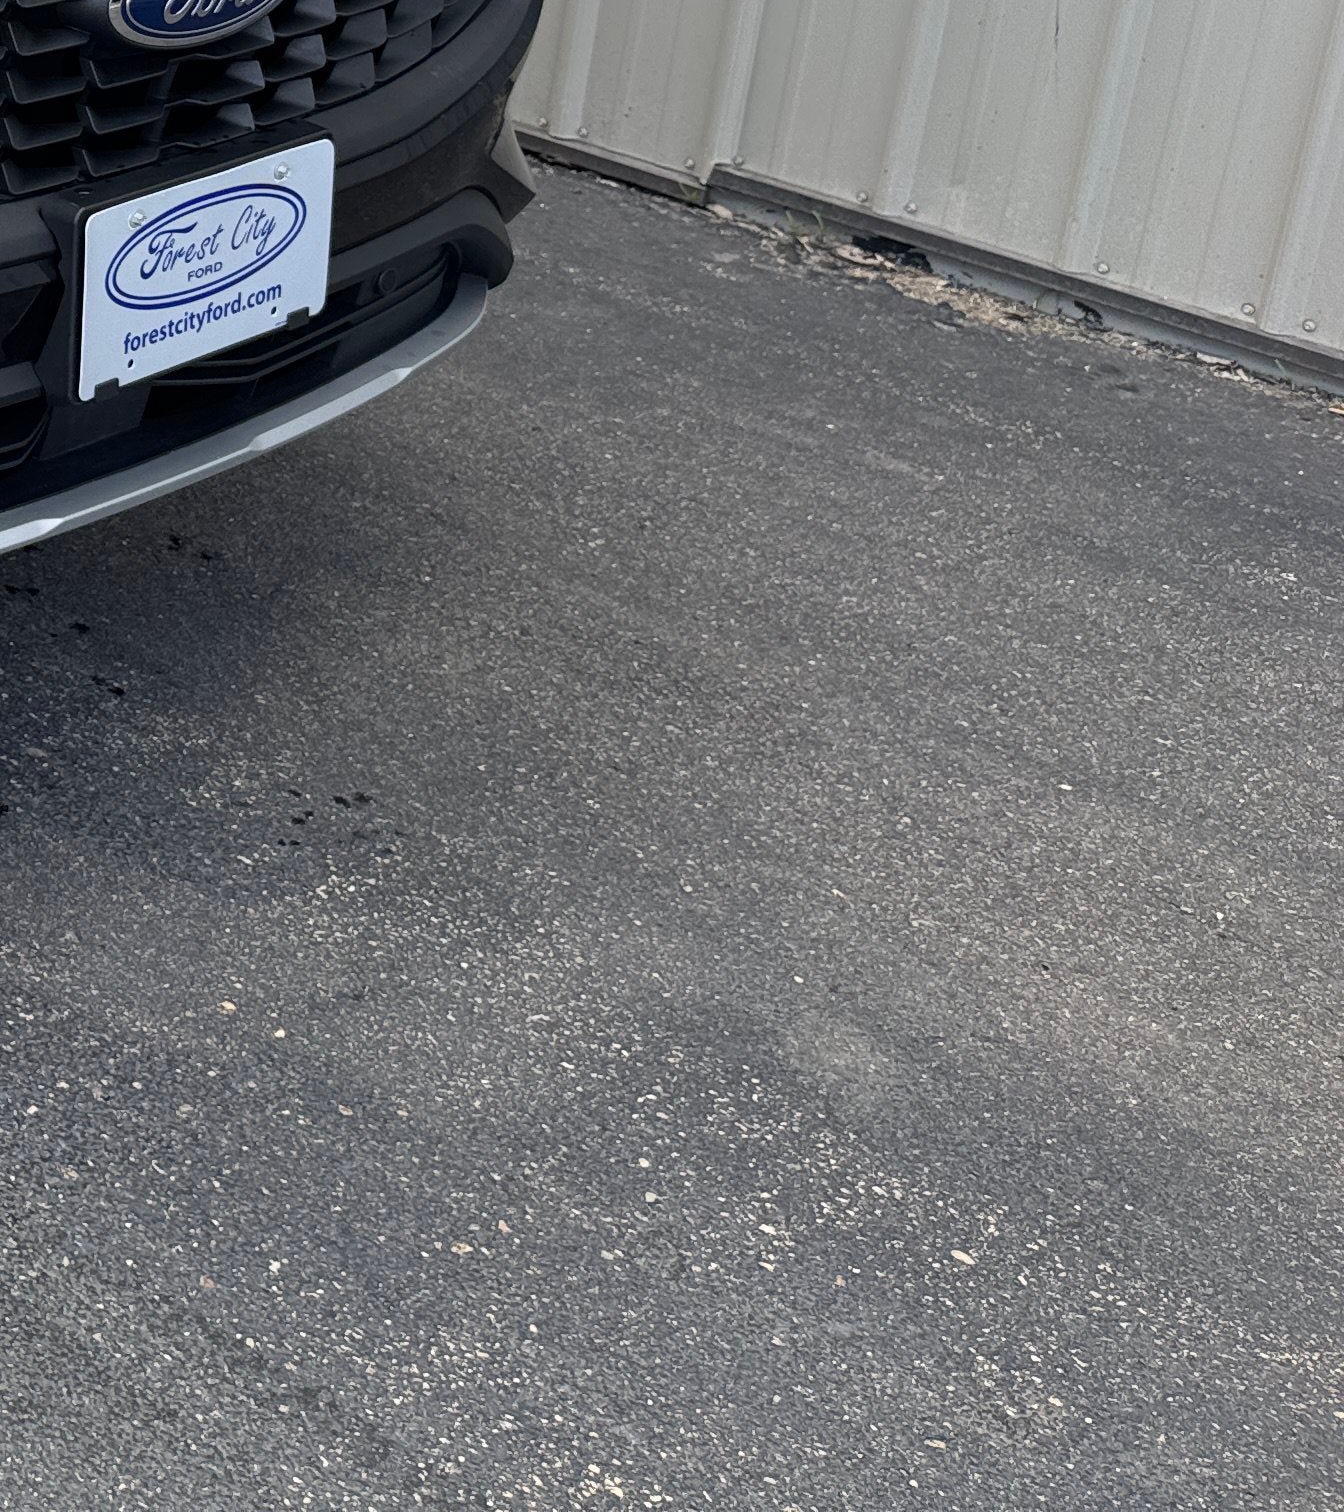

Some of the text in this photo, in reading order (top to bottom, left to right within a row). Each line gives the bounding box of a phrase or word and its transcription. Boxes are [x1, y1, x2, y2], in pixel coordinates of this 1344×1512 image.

[139, 204, 278, 280] Forest City
[187, 261, 224, 282] FORD
[123, 283, 282, 355] forestcityford.com
